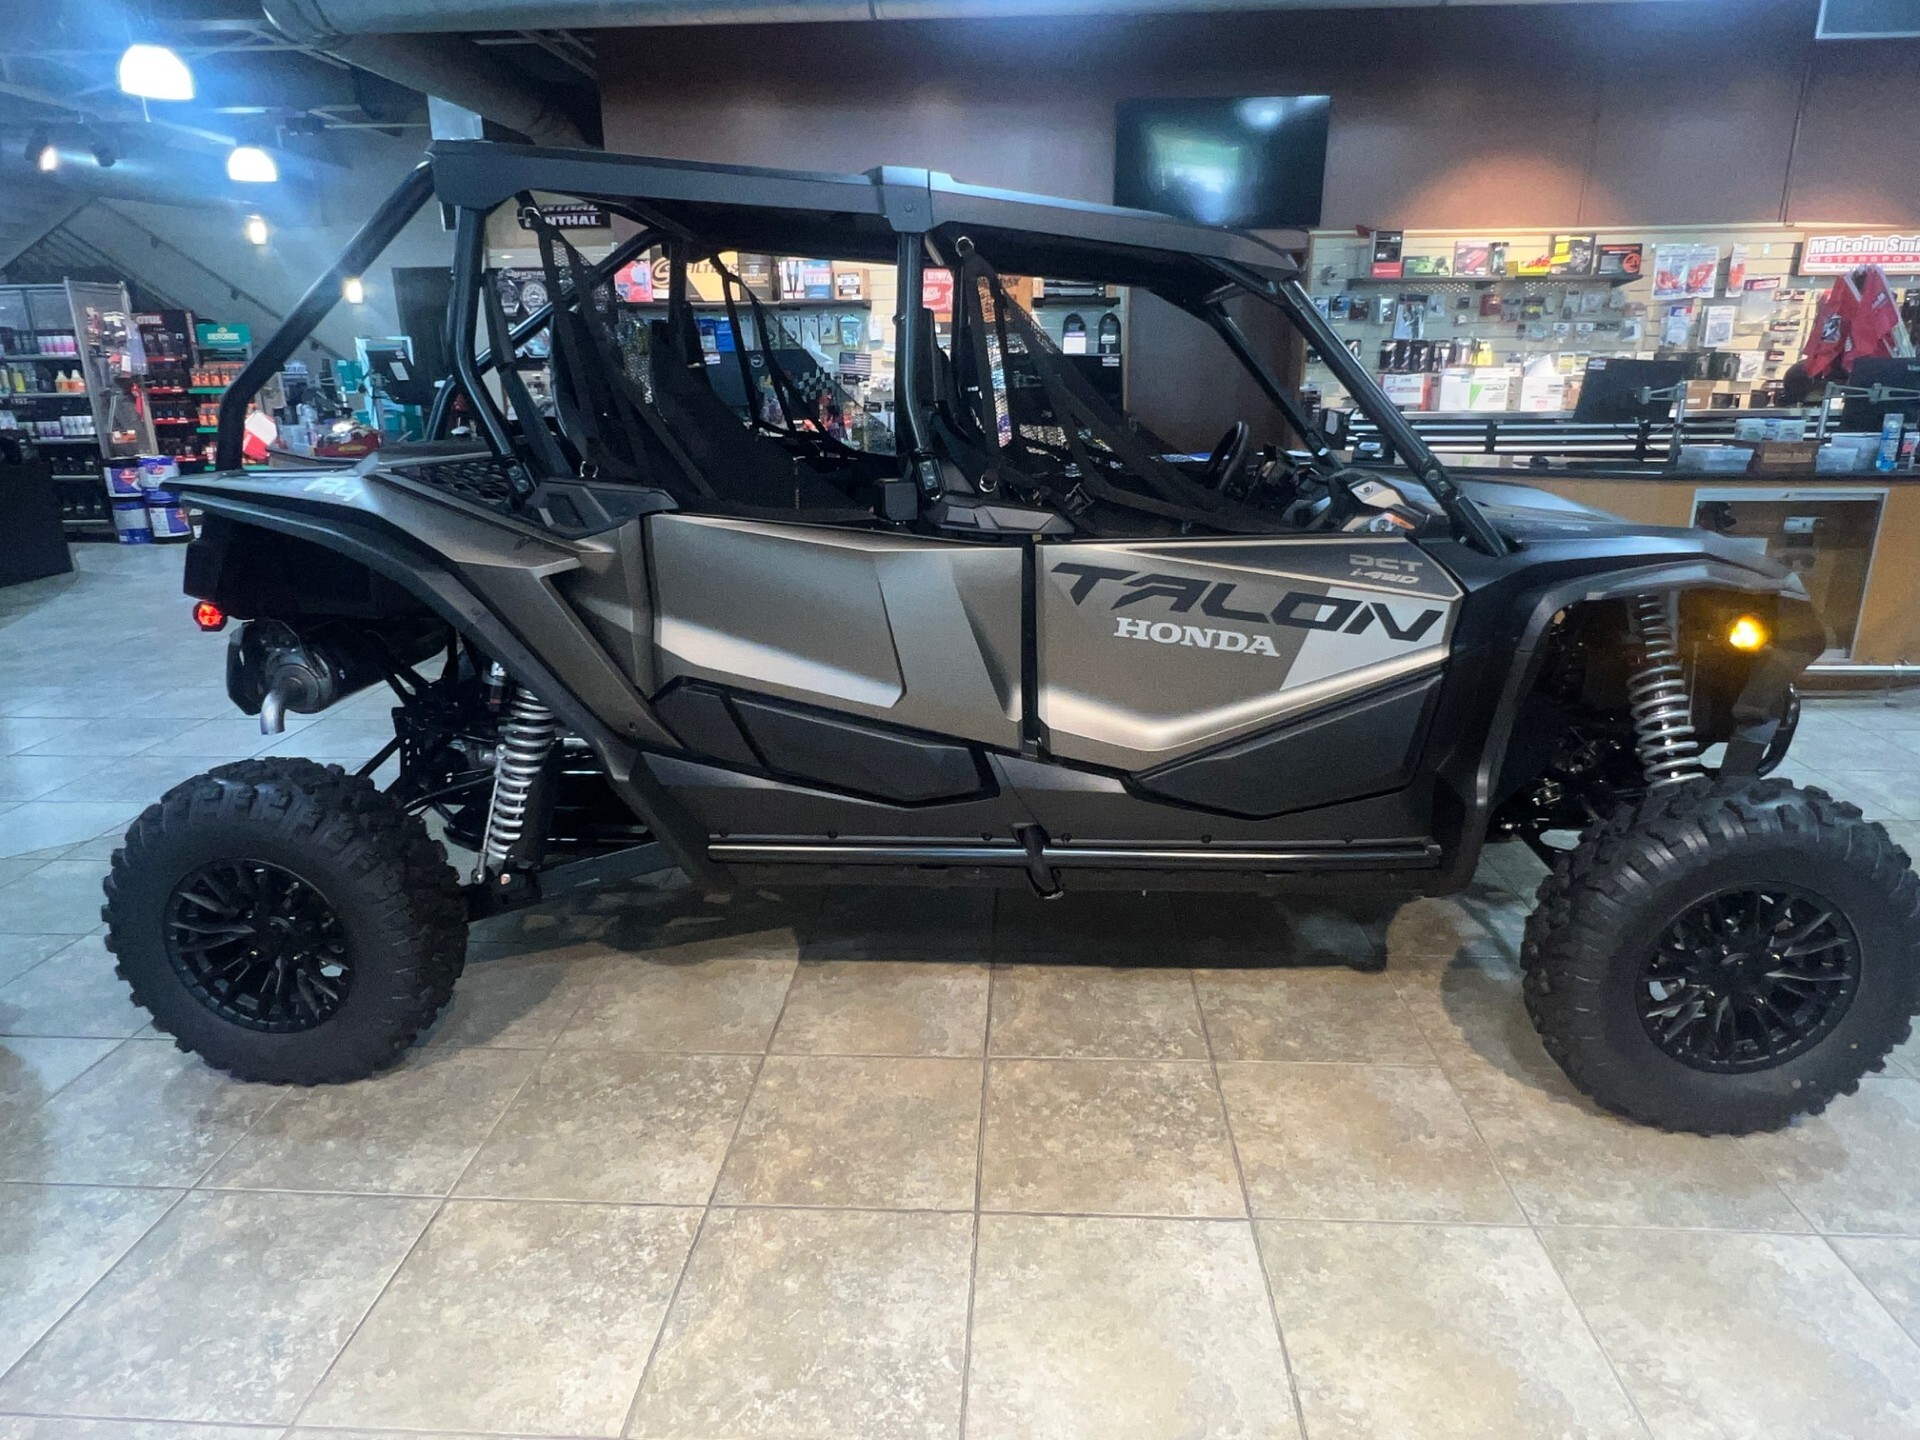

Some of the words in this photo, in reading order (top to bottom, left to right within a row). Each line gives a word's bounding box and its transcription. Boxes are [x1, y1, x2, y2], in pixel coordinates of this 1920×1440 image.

[543, 215, 601, 226] NTHAL
[1809, 237, 1885, 254] Malcolm
[1808, 255, 1920, 264] MOTORSPOR
[1349, 553, 1423, 572] DCT
[1051, 562, 1444, 642] TALON
[1113, 617, 1280, 658] HONDA
